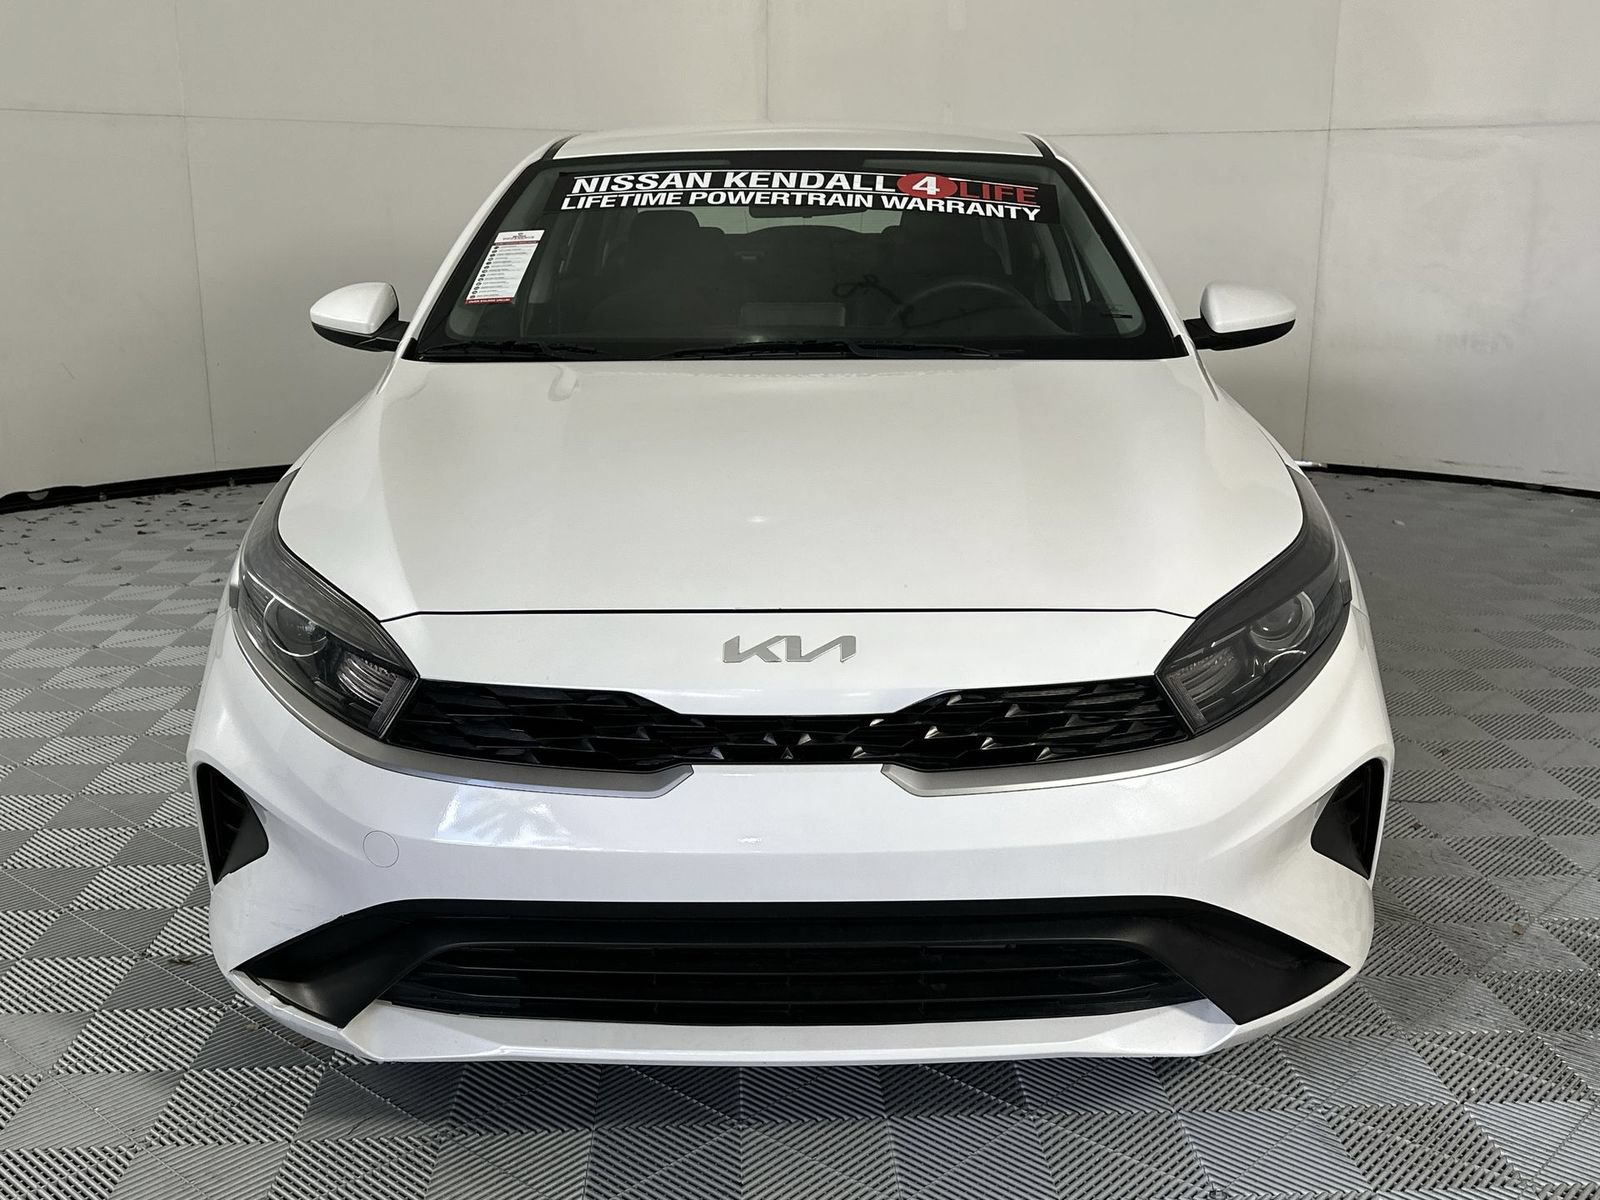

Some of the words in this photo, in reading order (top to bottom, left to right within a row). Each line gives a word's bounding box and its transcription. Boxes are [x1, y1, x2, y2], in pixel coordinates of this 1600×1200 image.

[571, 172, 712, 193] NISSAN
[723, 172, 896, 192] KENDALL
[911, 176, 940, 195] 4
[960, 181, 1038, 204] LIFE
[561, 193, 681, 209] LIFETIME
[688, 192, 873, 207] POWERTRAIN
[881, 196, 1040, 221] WARRANTY
